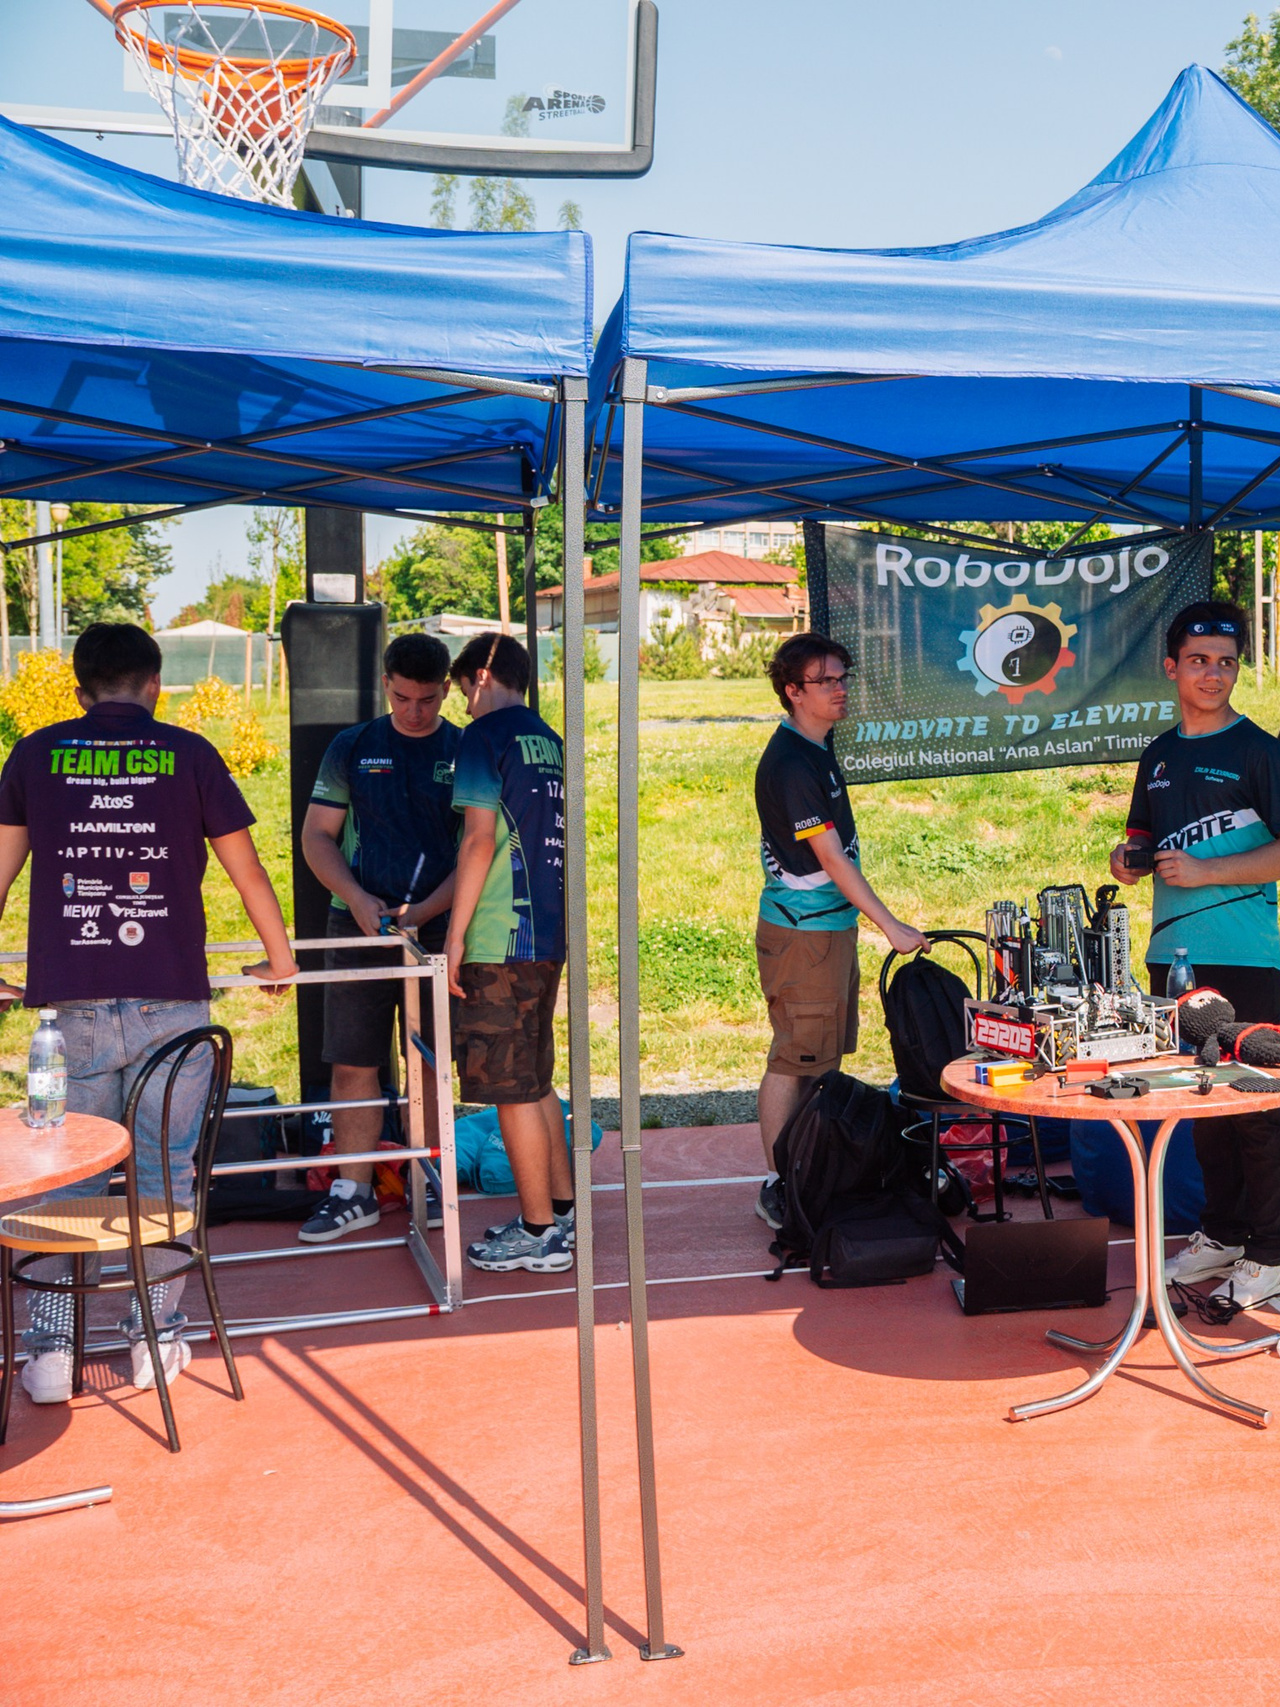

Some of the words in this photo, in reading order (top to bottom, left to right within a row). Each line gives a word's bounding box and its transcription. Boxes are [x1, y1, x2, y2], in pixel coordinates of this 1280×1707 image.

[522, 96, 585, 112] ARENA
[876, 543, 1170, 594] RoboDojo
[855, 715, 990, 743] INNOVATE
[1003, 714, 1040, 736] TO
[1050, 700, 1176, 732] ELEVATE
[50, 748, 121, 776] TEAM
[126, 749, 175, 775] CSH
[515, 734, 563, 768] TEAM
[843, 751, 915, 772] Colegiul
[66, 776, 92, 785] dream
[70, 822, 156, 834] HAMILTON
[976, 1017, 1033, 1054] 23205
